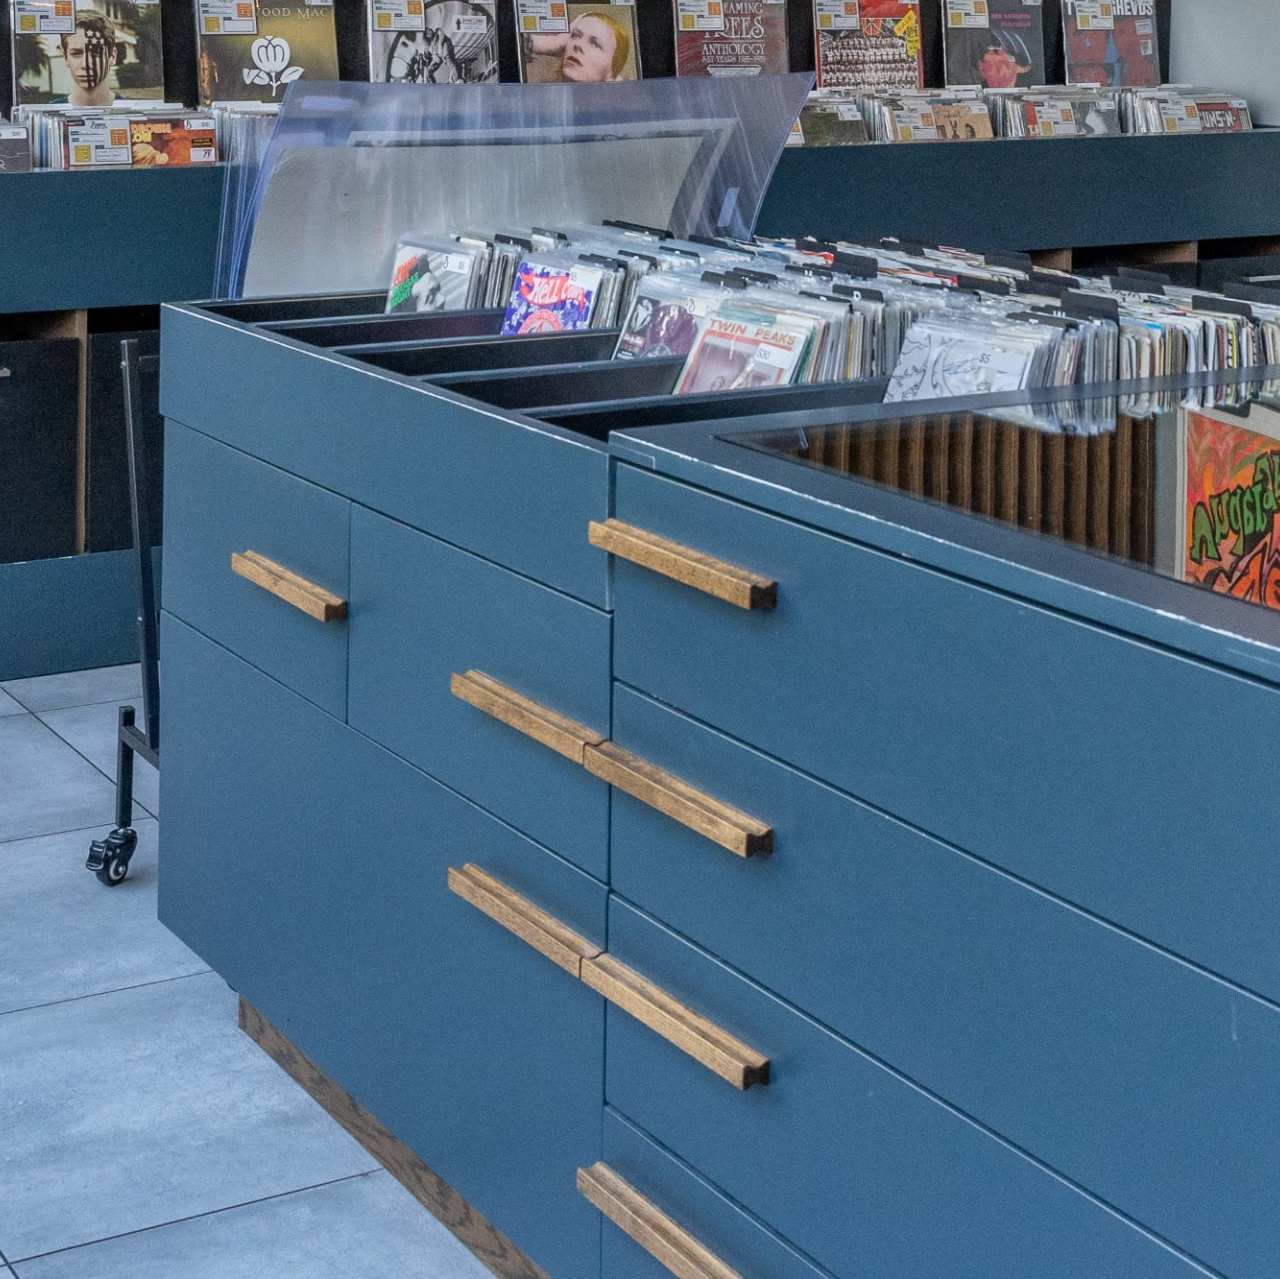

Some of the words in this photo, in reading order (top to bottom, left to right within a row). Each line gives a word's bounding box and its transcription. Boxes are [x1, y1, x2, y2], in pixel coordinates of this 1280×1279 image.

[702, 43, 765, 55] ANTHOLOGY
[710, 320, 747, 335] TWIN
[754, 328, 796, 346] PEAKS
